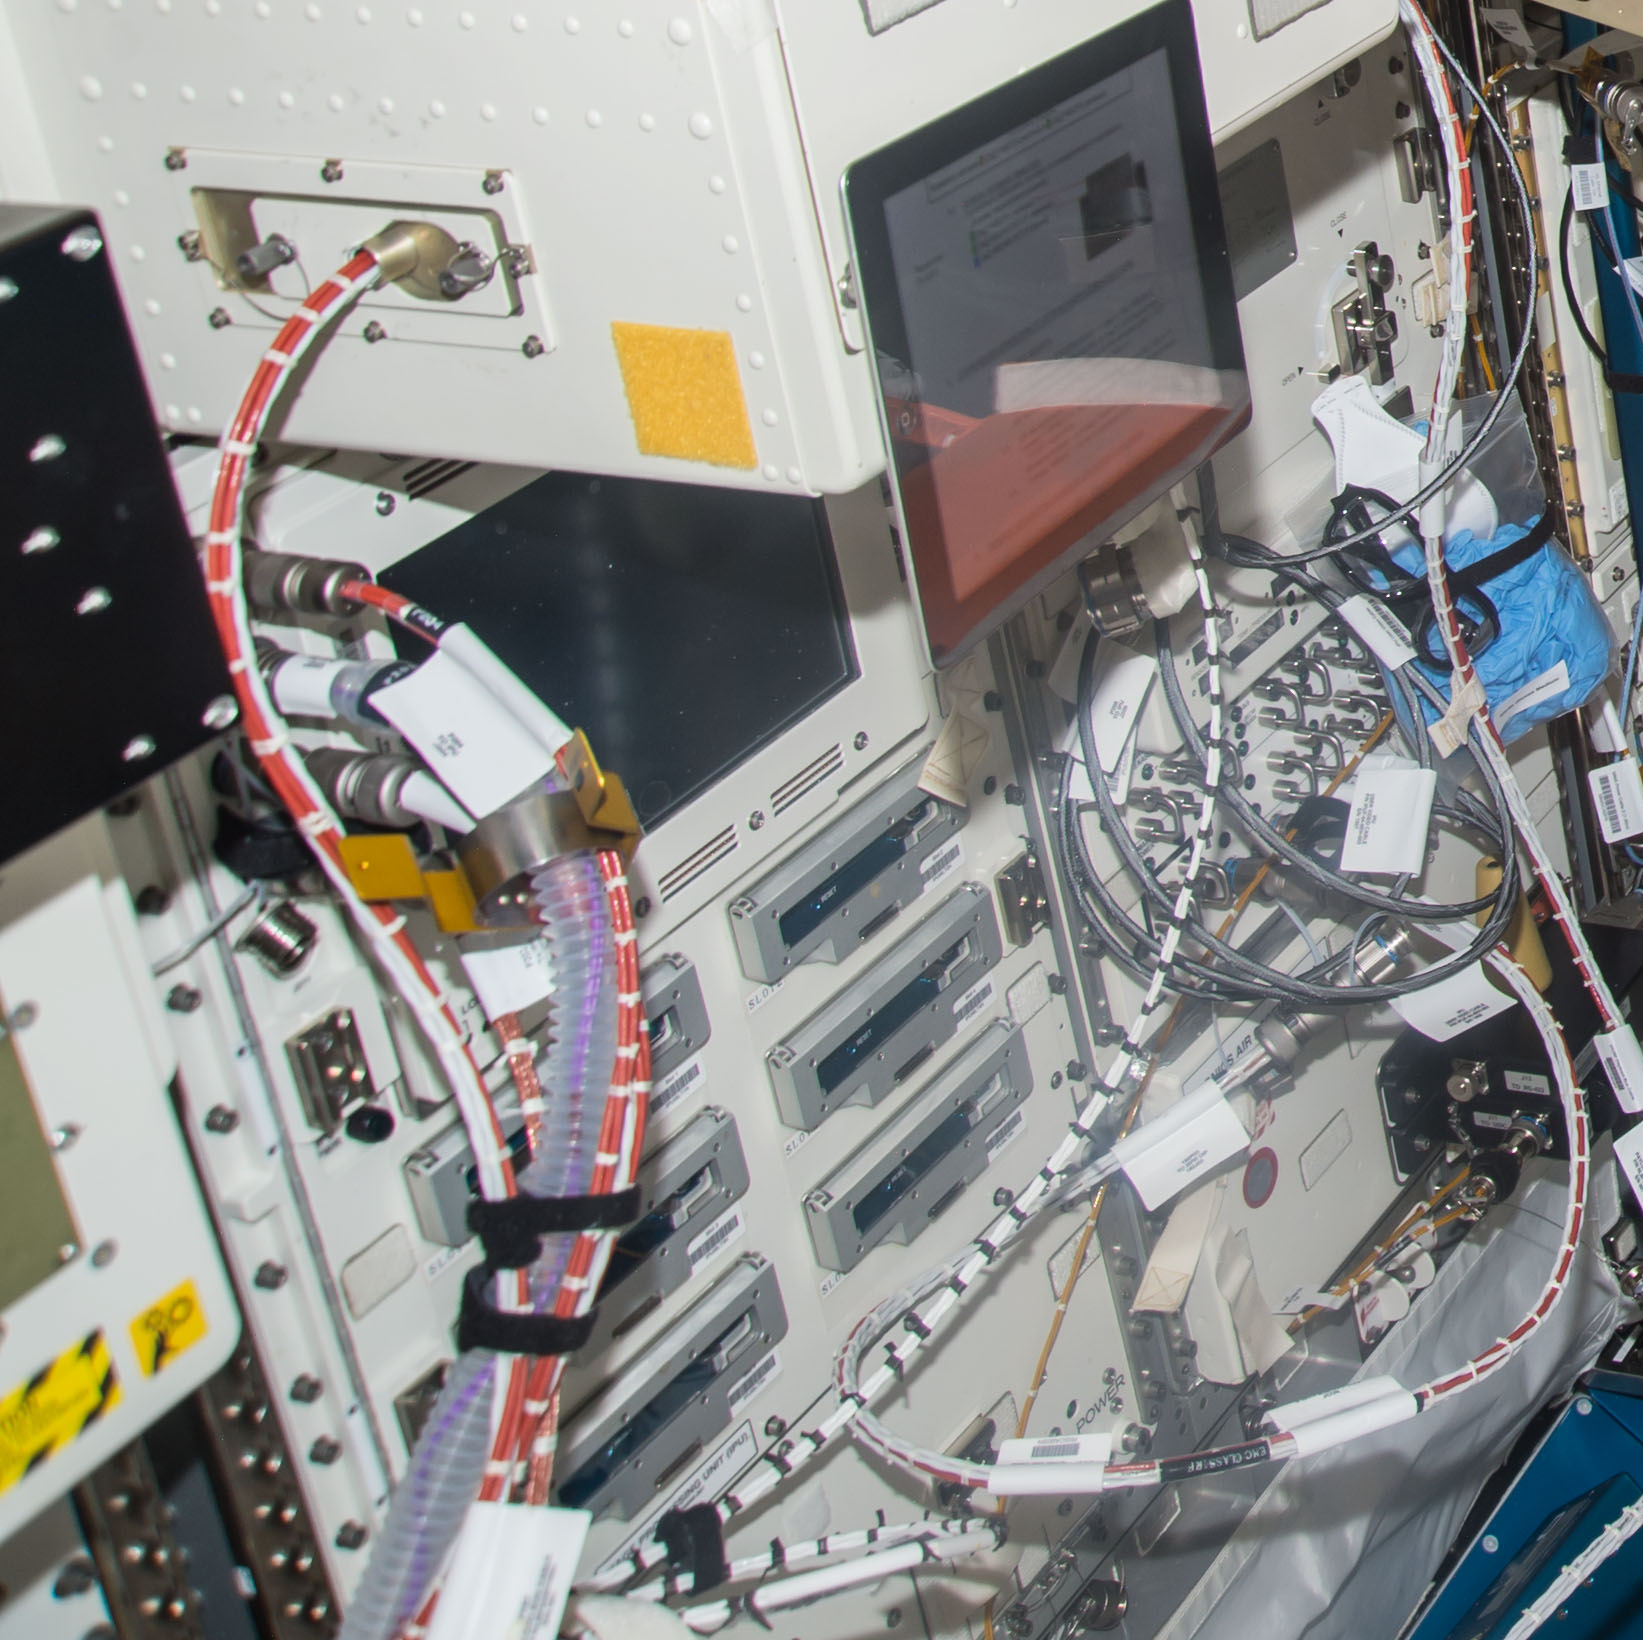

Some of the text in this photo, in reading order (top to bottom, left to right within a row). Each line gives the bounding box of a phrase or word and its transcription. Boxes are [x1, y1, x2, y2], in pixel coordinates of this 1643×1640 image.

[819, 884, 839, 904] RESET
[1231, 1034, 1254, 1058] AIR
[1074, 1373, 1128, 1435] POWER
[700, 1454, 727, 1481] UNIT
[722, 1430, 750, 1459] (IPU)
[1242, 1446, 1267, 1462] EMC
